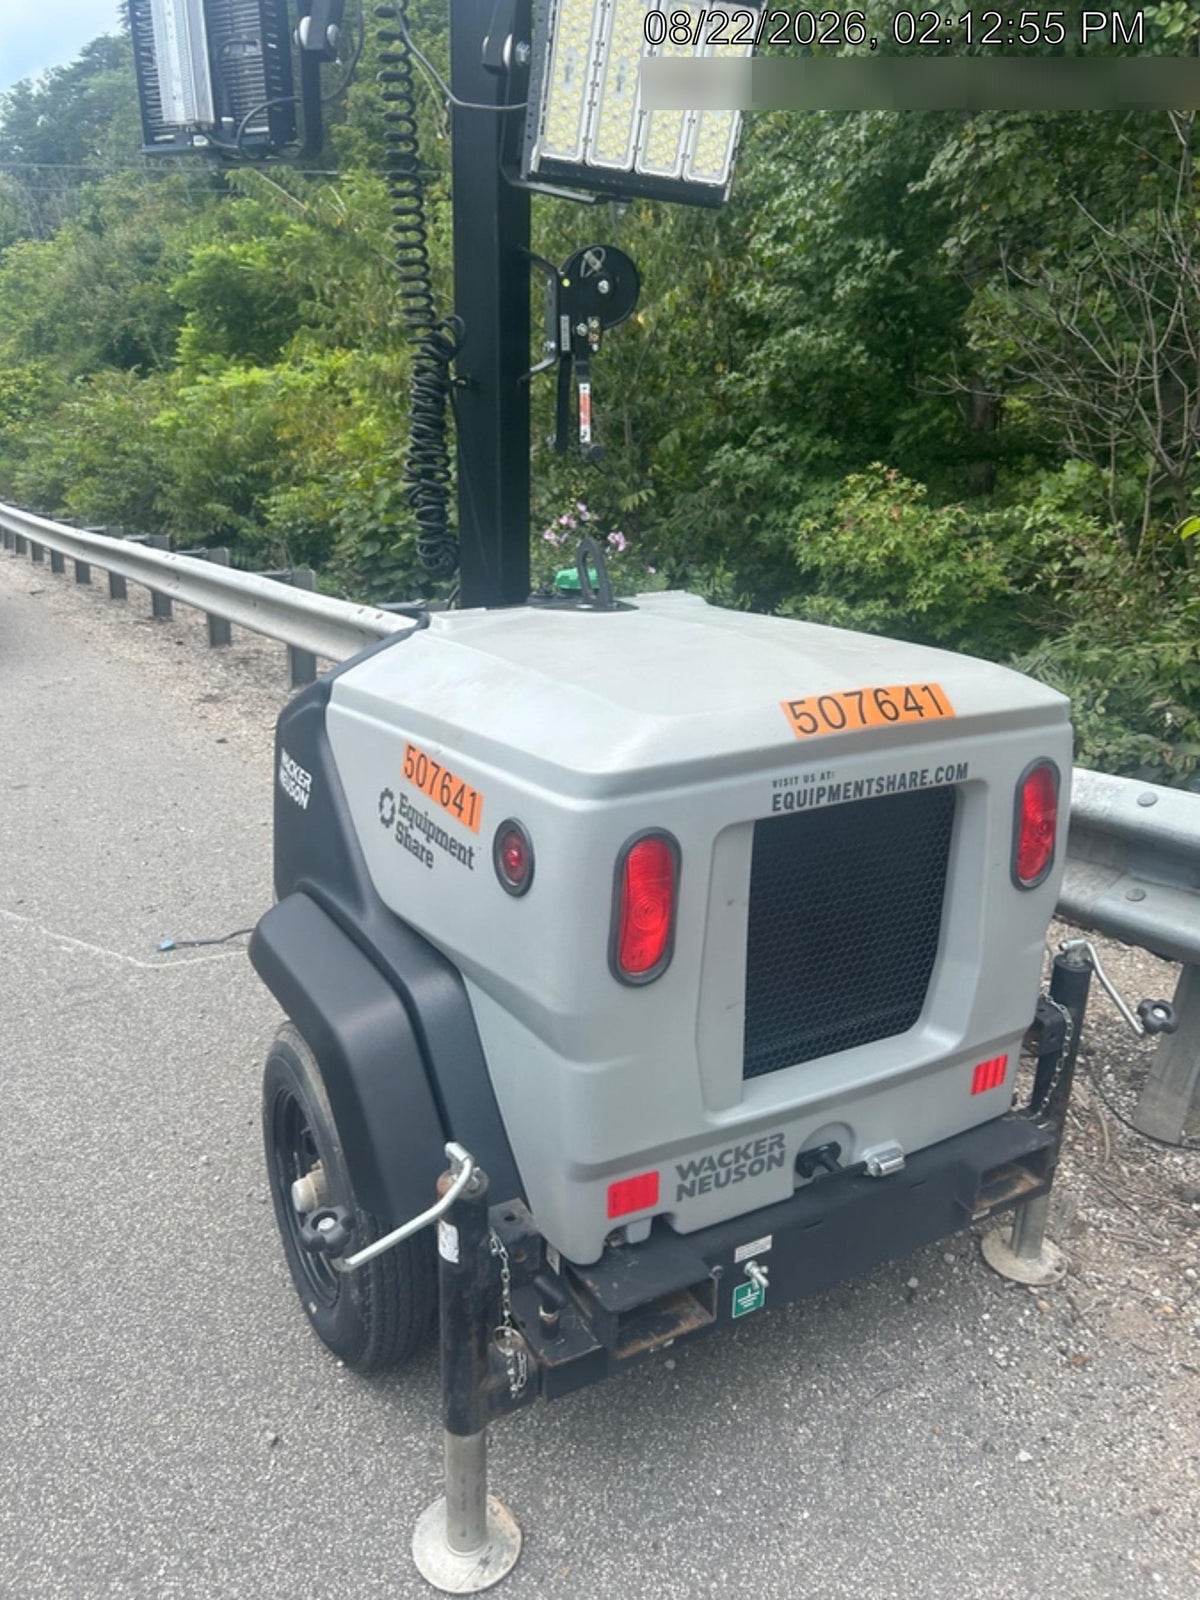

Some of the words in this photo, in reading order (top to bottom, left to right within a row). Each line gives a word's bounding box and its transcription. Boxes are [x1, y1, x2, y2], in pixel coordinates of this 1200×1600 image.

[788, 685, 944, 734] 507641
[404, 745, 477, 826] 507641
[772, 776, 799, 788] VISIT
[803, 773, 816, 784] US
[772, 762, 968, 812] EQUIPMENTSHARE.COM
[395, 820, 434, 869] Share
[399, 792, 475, 870] Equipment
[675, 1132, 786, 1181] WACKER
[676, 1151, 785, 1202] NEUSON
